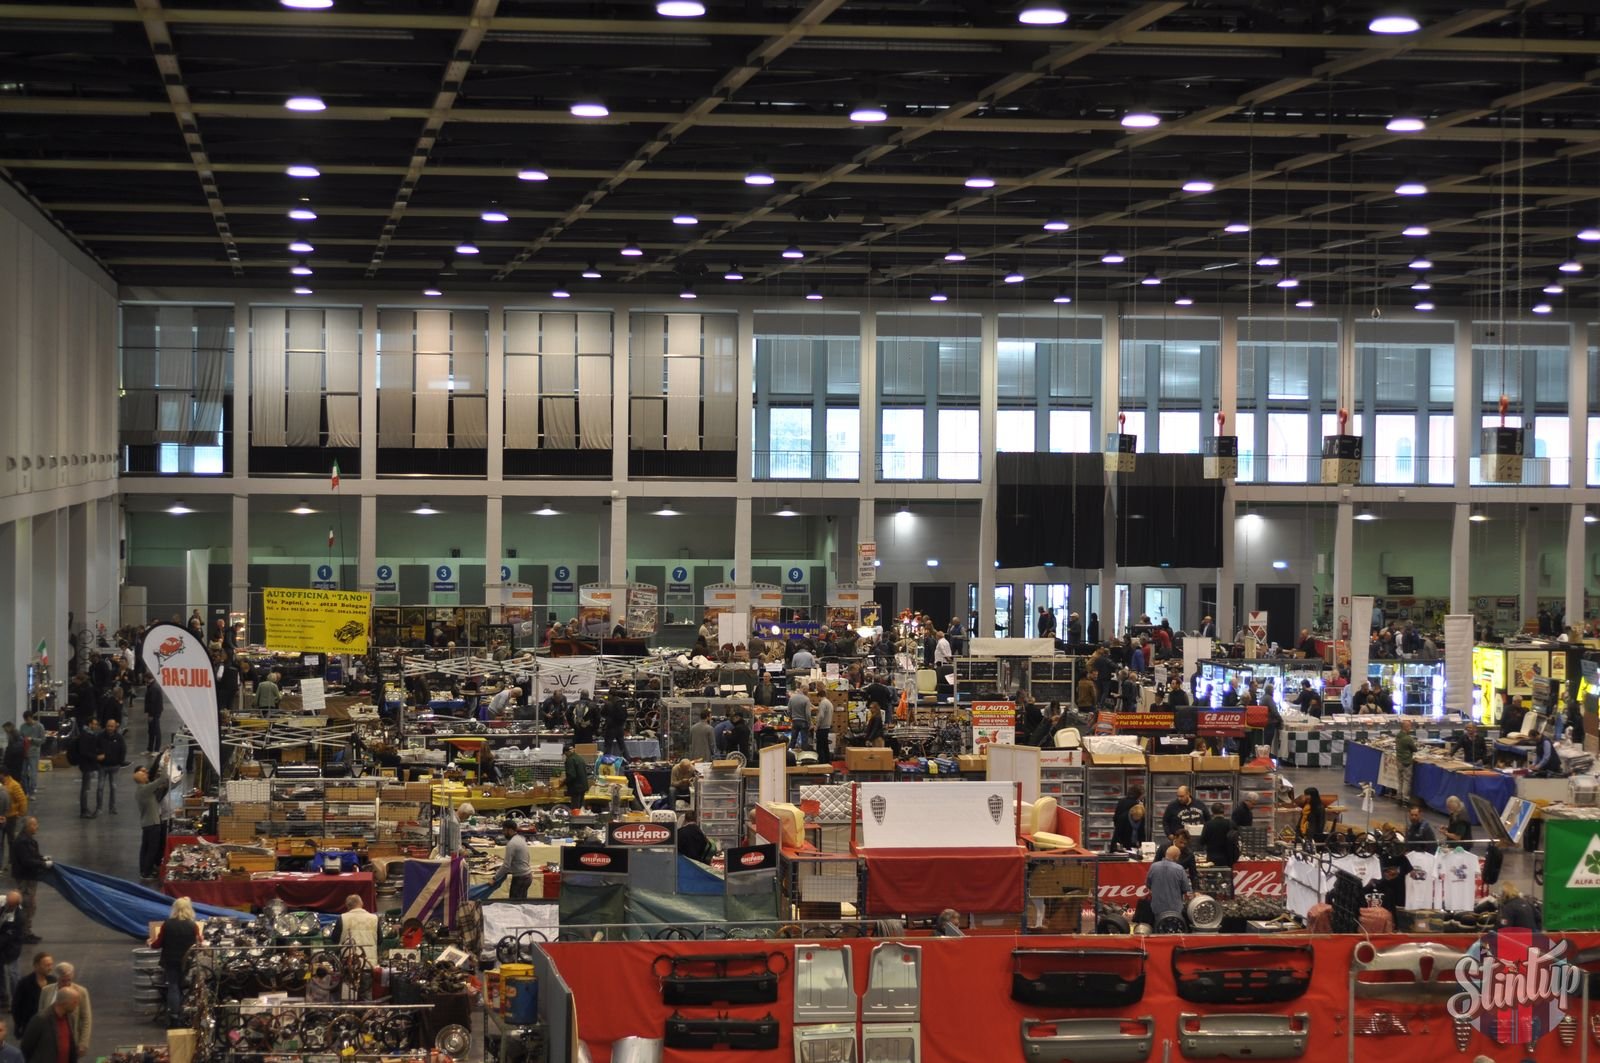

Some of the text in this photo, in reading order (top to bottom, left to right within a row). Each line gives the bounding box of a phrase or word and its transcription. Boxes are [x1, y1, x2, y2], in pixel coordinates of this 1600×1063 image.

[381, 569, 388, 577] 2
[440, 569, 446, 577] 3
[559, 570, 565, 578] 5
[792, 570, 798, 579] 9
[266, 591, 328, 600] AUTOFFICINA
[1204, 713, 1218, 721] GB
[614, 830, 670, 839] GHIPARD
[741, 855, 764, 864] GHIPARD
[1098, 884, 1150, 898] meo
